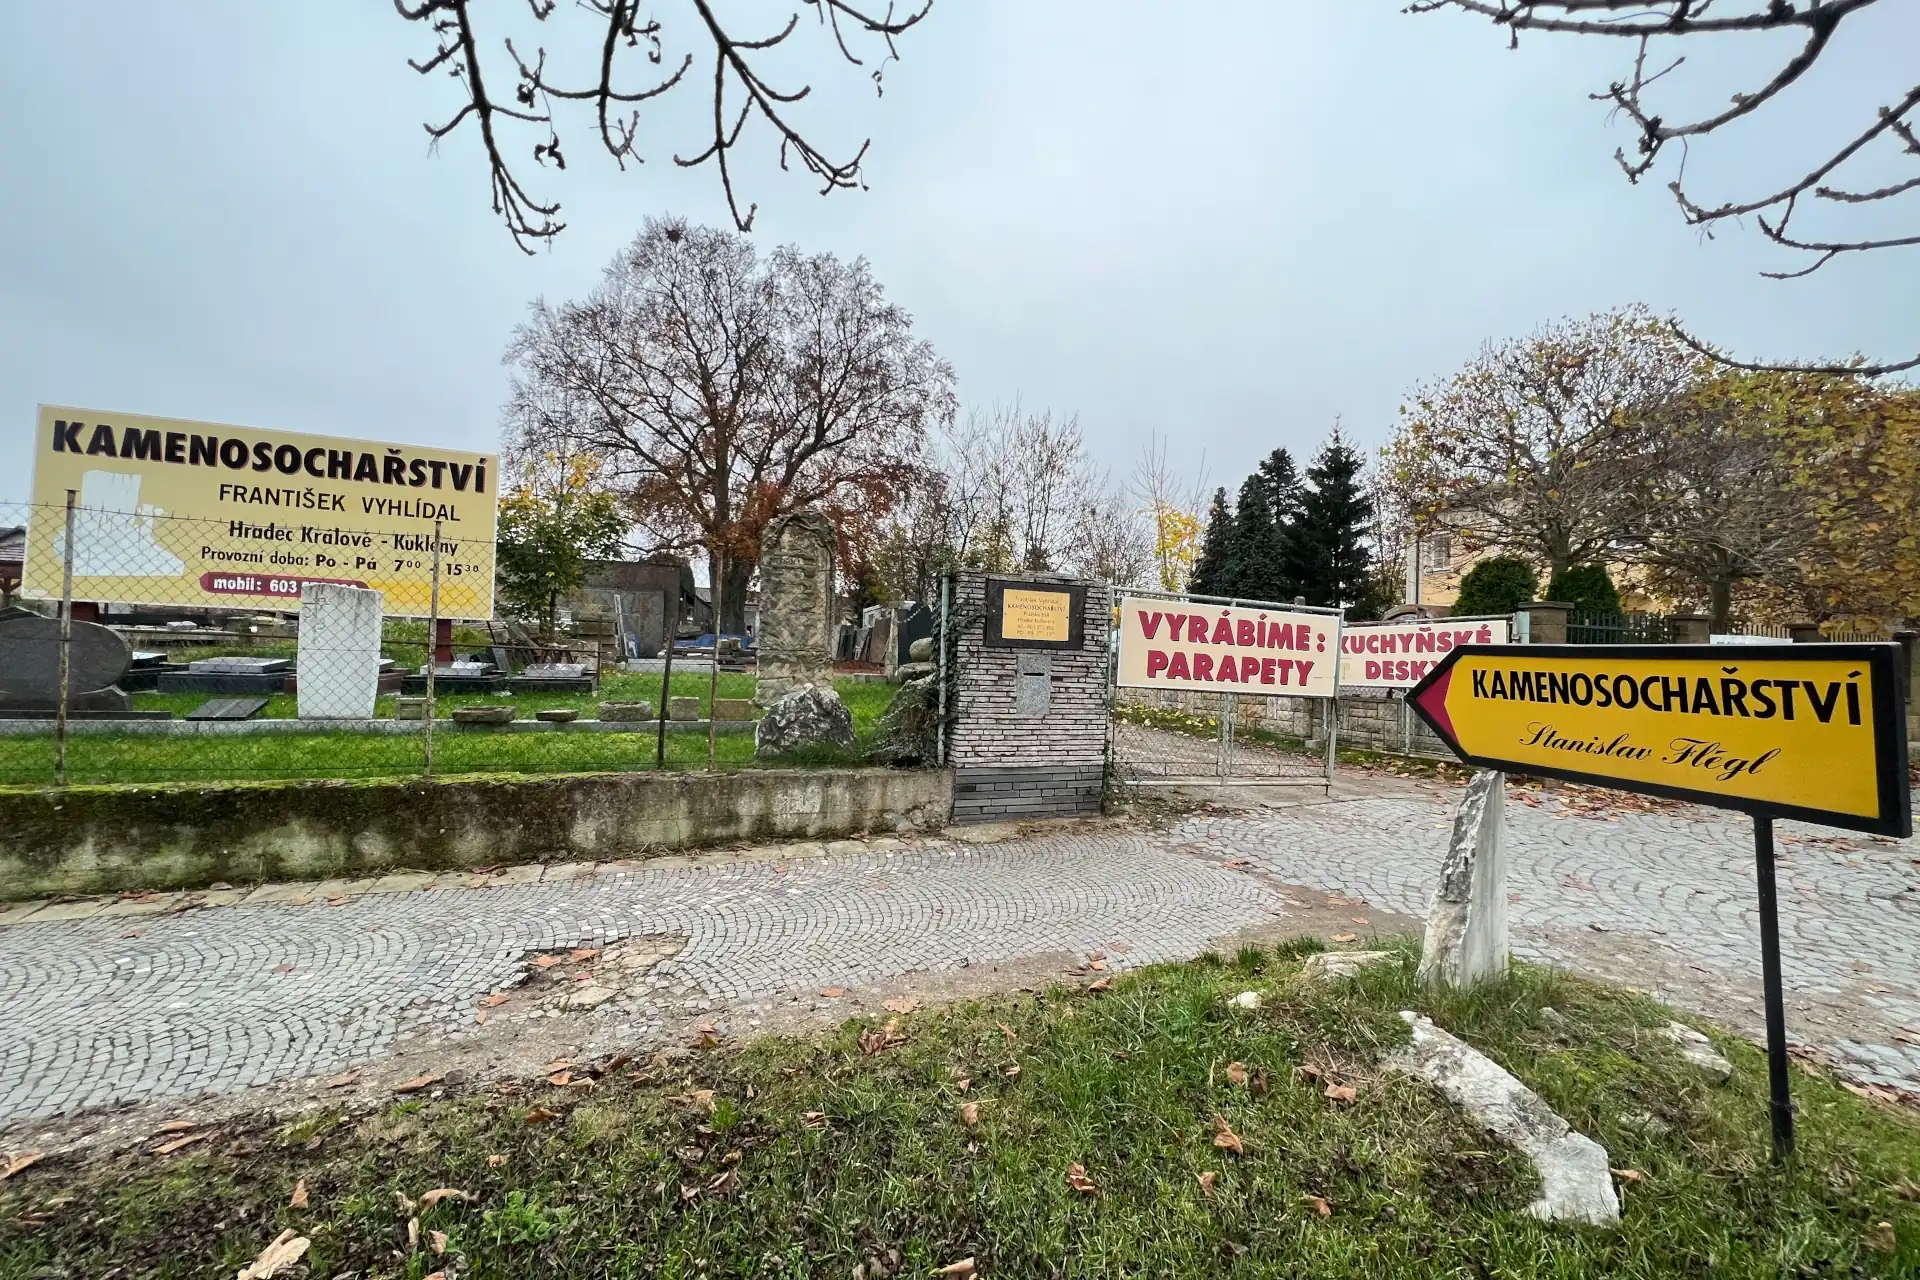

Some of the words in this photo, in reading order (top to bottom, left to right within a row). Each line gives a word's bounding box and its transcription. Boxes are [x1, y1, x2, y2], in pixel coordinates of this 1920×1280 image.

[52, 418, 487, 494] KAMENOSOCHAŘSTVÍ
[219, 483, 346, 512] FRANTIŠEK
[361, 496, 461, 522] VYHLÍDAL
[229, 520, 293, 542] Hradec
[201, 545, 263, 564] Provozní
[269, 549, 309, 567] doba:
[315, 554, 336, 568] Po
[355, 556, 377, 571] Pá
[213, 576, 262, 591] mobil:
[269, 579, 297, 593] 603
[1146, 650, 1315, 686] PARAPETY
[1472, 666, 1863, 726] KAMENOSOCHAŘSTVÍ
[1519, 721, 1653, 762] Stanislav
